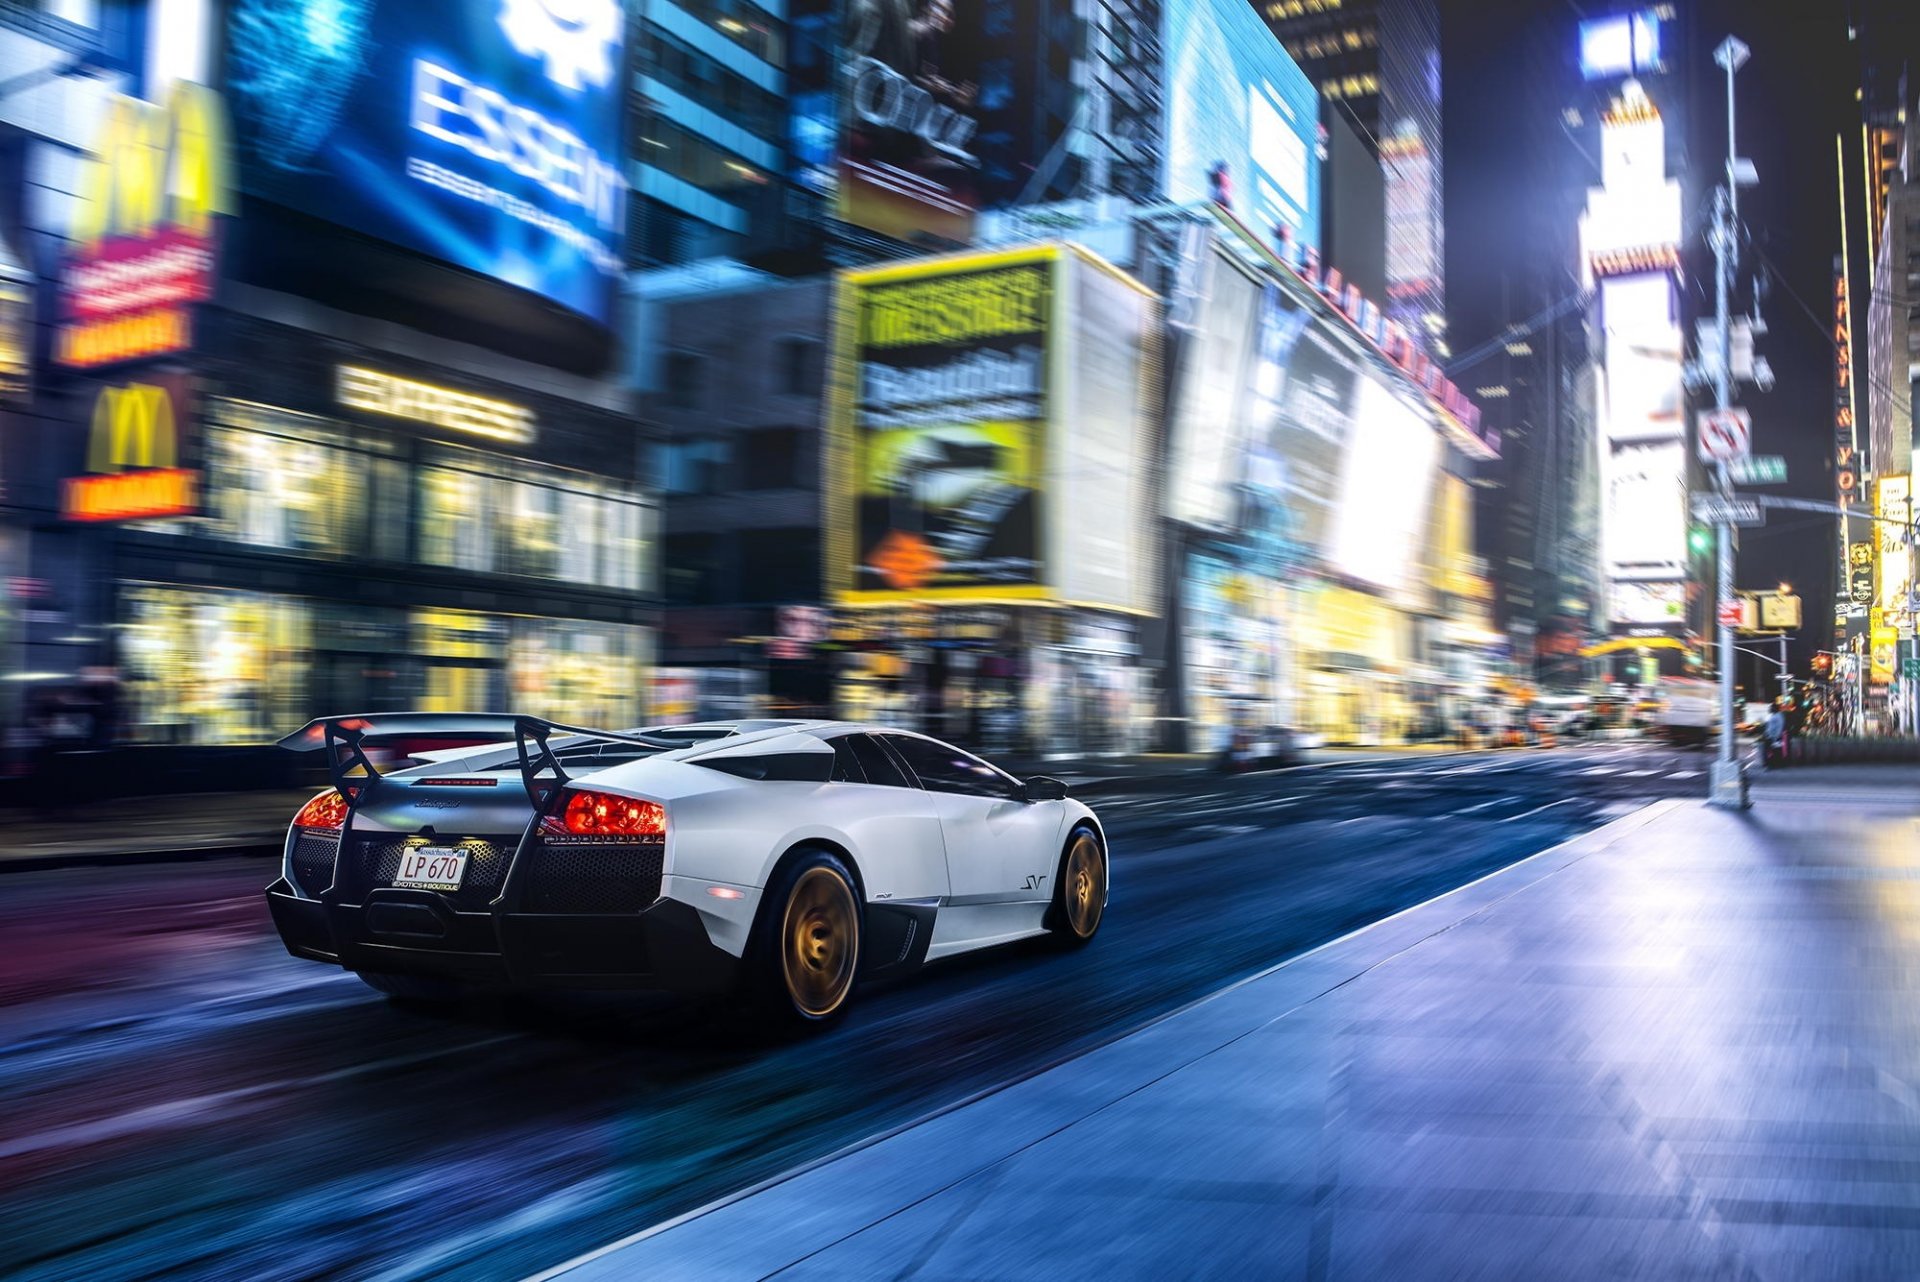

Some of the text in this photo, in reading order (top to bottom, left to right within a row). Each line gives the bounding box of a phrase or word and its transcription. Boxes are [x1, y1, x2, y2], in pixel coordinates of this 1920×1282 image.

[404, 856, 459, 880] LP 670
[392, 881, 459, 892] EXOTICS BOUTIQUE
